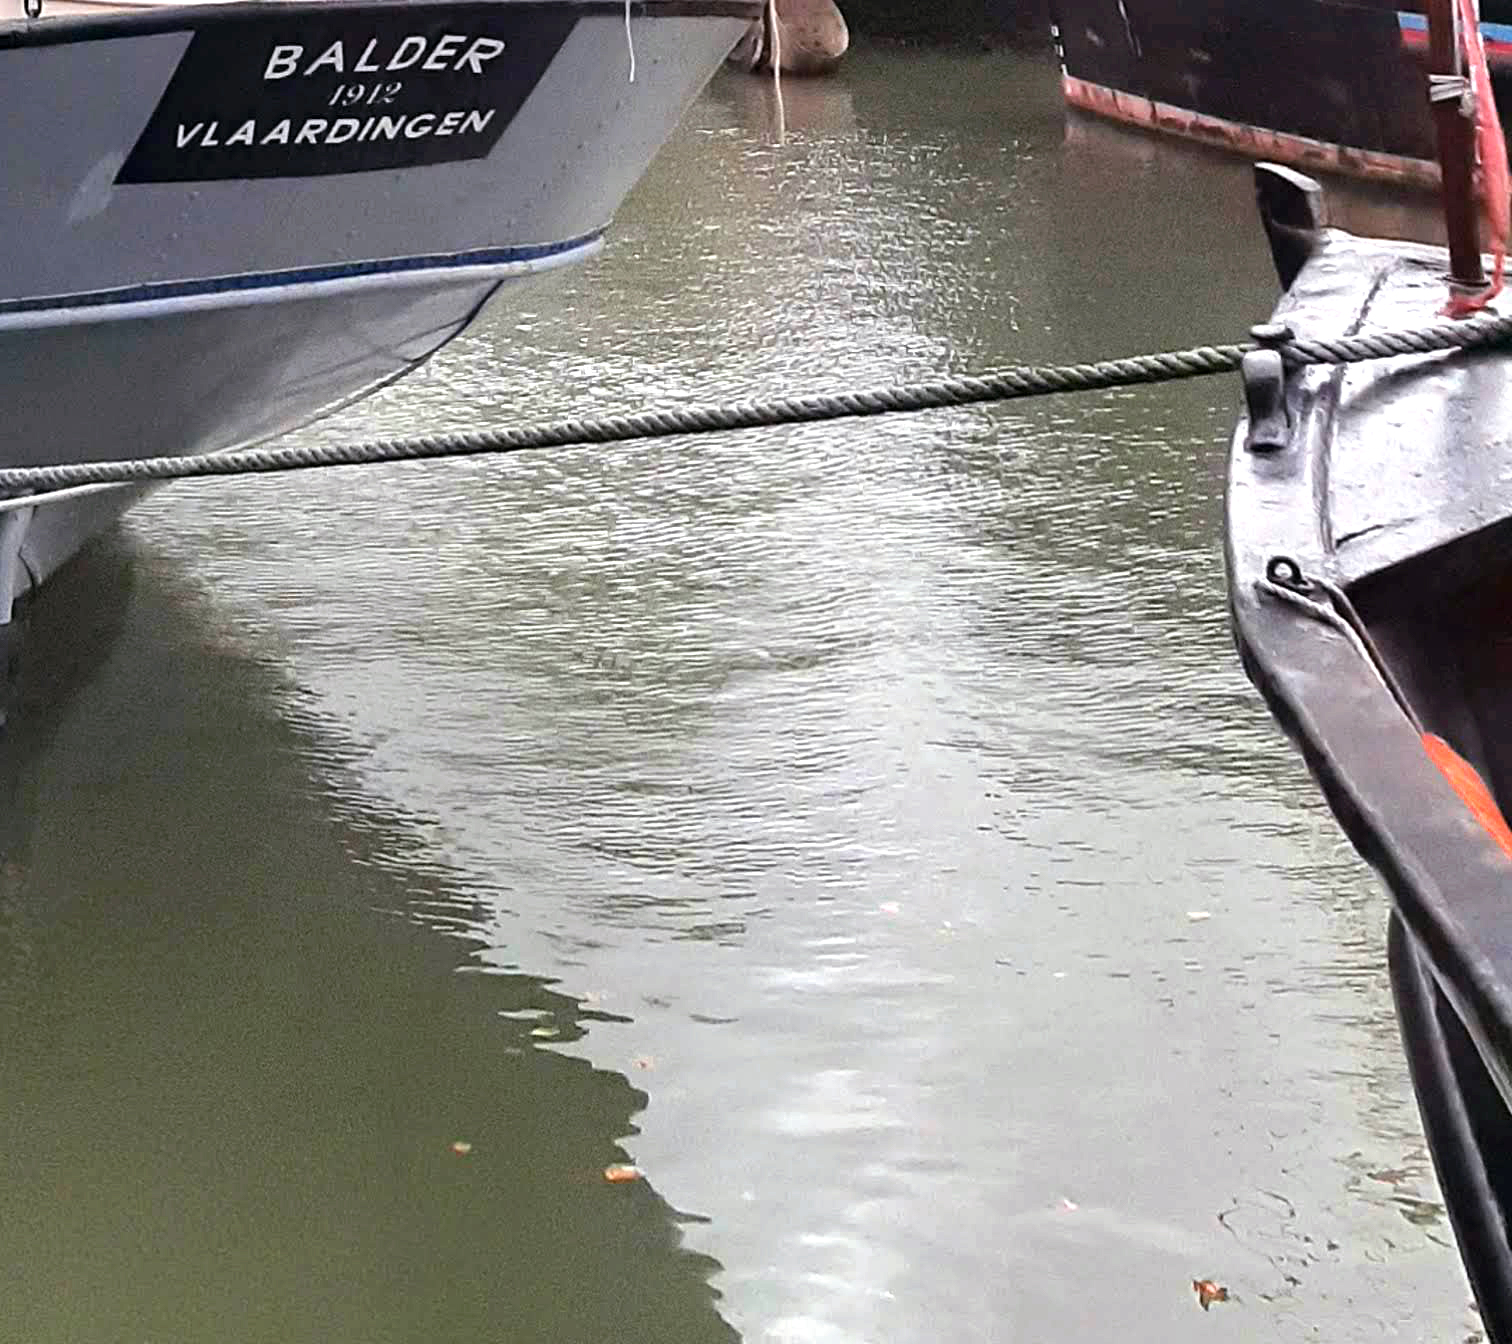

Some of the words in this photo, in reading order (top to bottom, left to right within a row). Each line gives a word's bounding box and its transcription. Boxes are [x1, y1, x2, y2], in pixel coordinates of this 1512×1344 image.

[263, 33, 506, 81] BALDER
[327, 81, 402, 107] 1912
[175, 108, 496, 150] VLAARDINGEN
